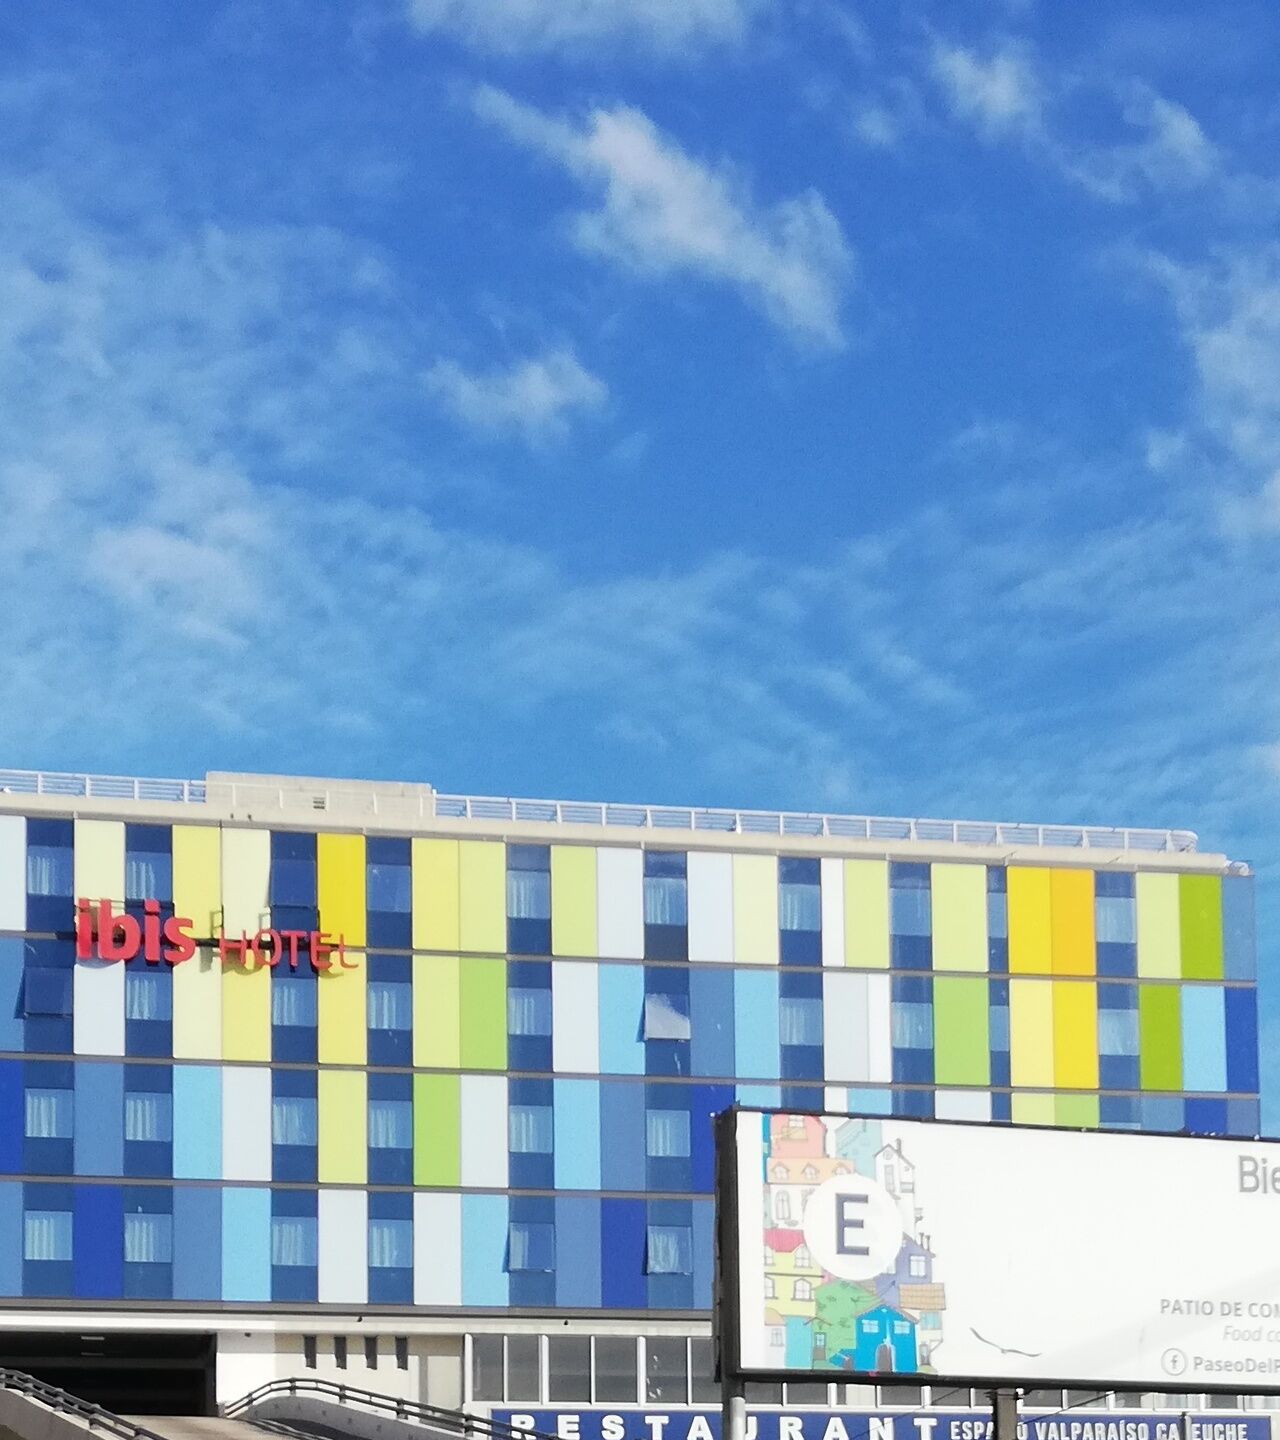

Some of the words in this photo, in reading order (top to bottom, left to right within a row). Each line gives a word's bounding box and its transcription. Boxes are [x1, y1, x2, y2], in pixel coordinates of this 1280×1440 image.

[76, 897, 196, 966] ibis
[220, 927, 359, 971] HOTEL
[835, 1192, 870, 1256] E
[1160, 1299, 1214, 1316] PATIO
[1220, 1301, 1243, 1317] DE
[1223, 1325, 1263, 1342] Food
[950, 1420, 1029, 1440] ESPAO
